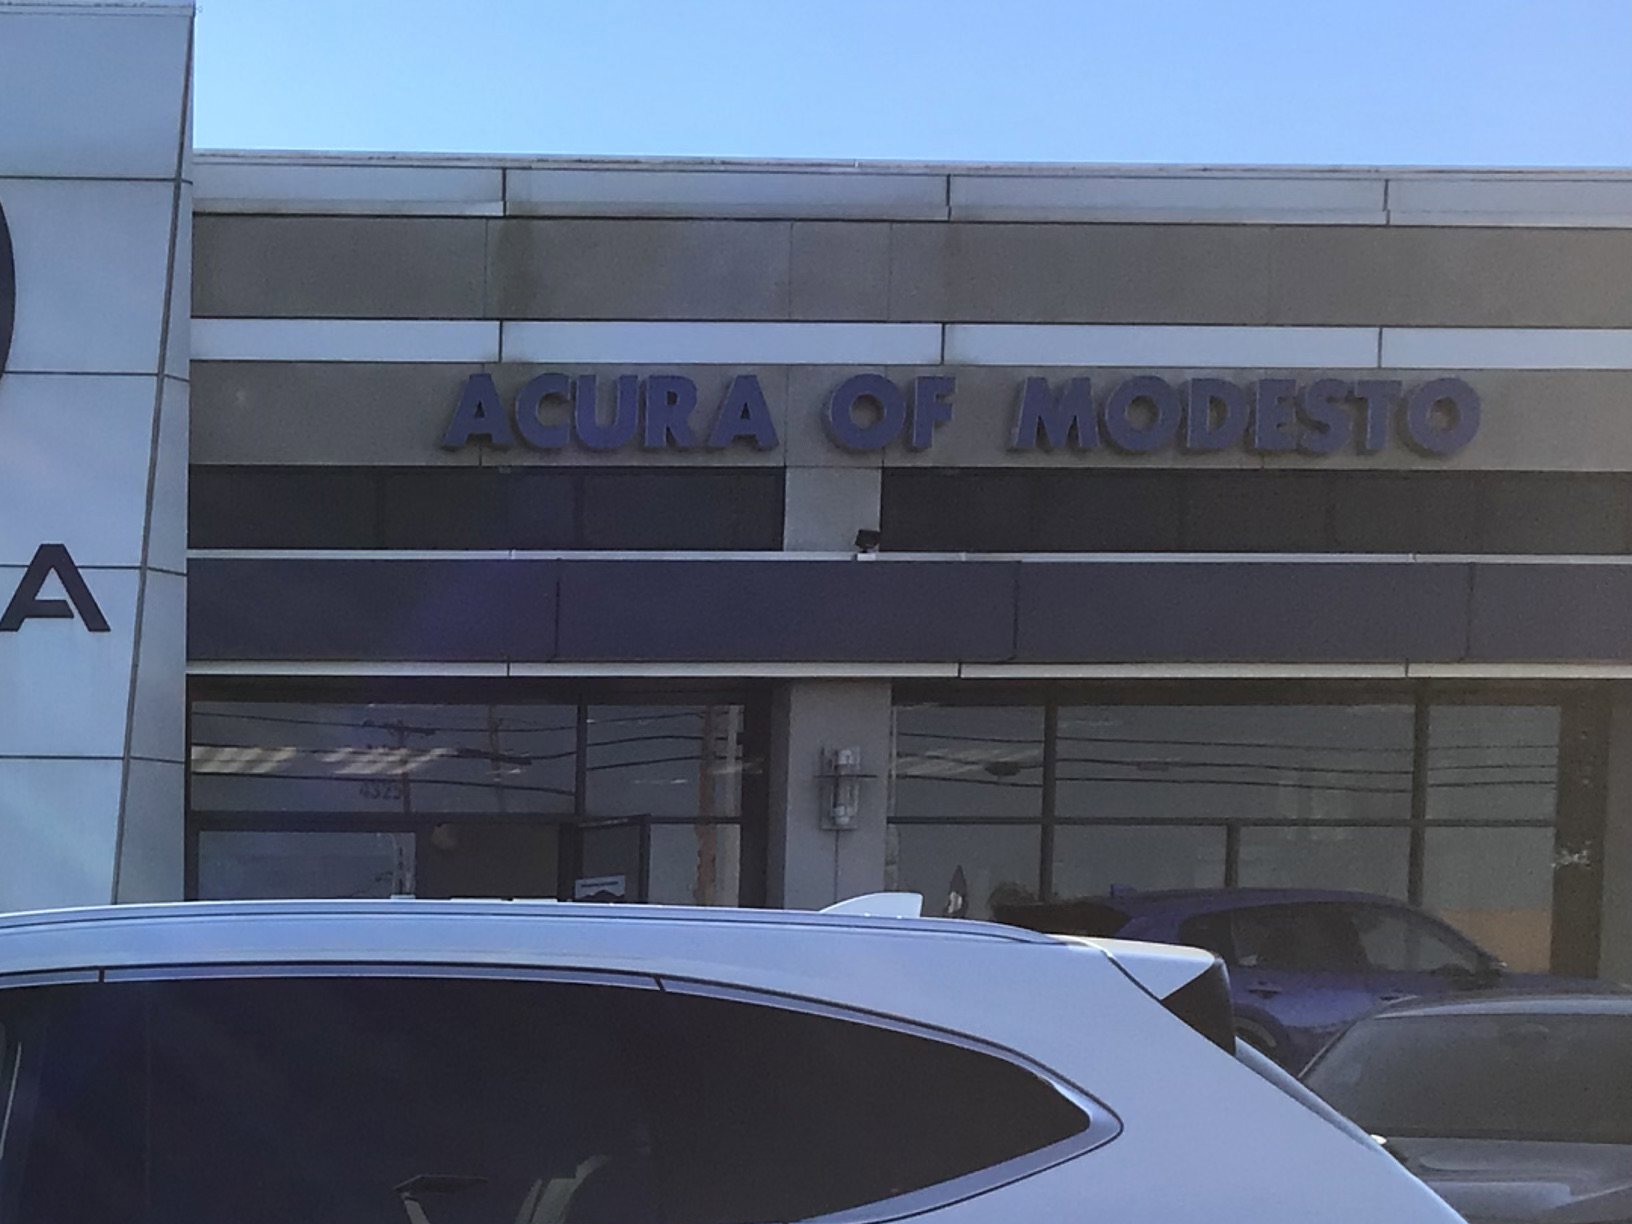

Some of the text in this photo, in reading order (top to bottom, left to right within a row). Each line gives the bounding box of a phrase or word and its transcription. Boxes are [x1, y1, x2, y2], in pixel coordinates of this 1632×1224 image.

[441, 373, 1482, 455] ACURA OF MODESTO
